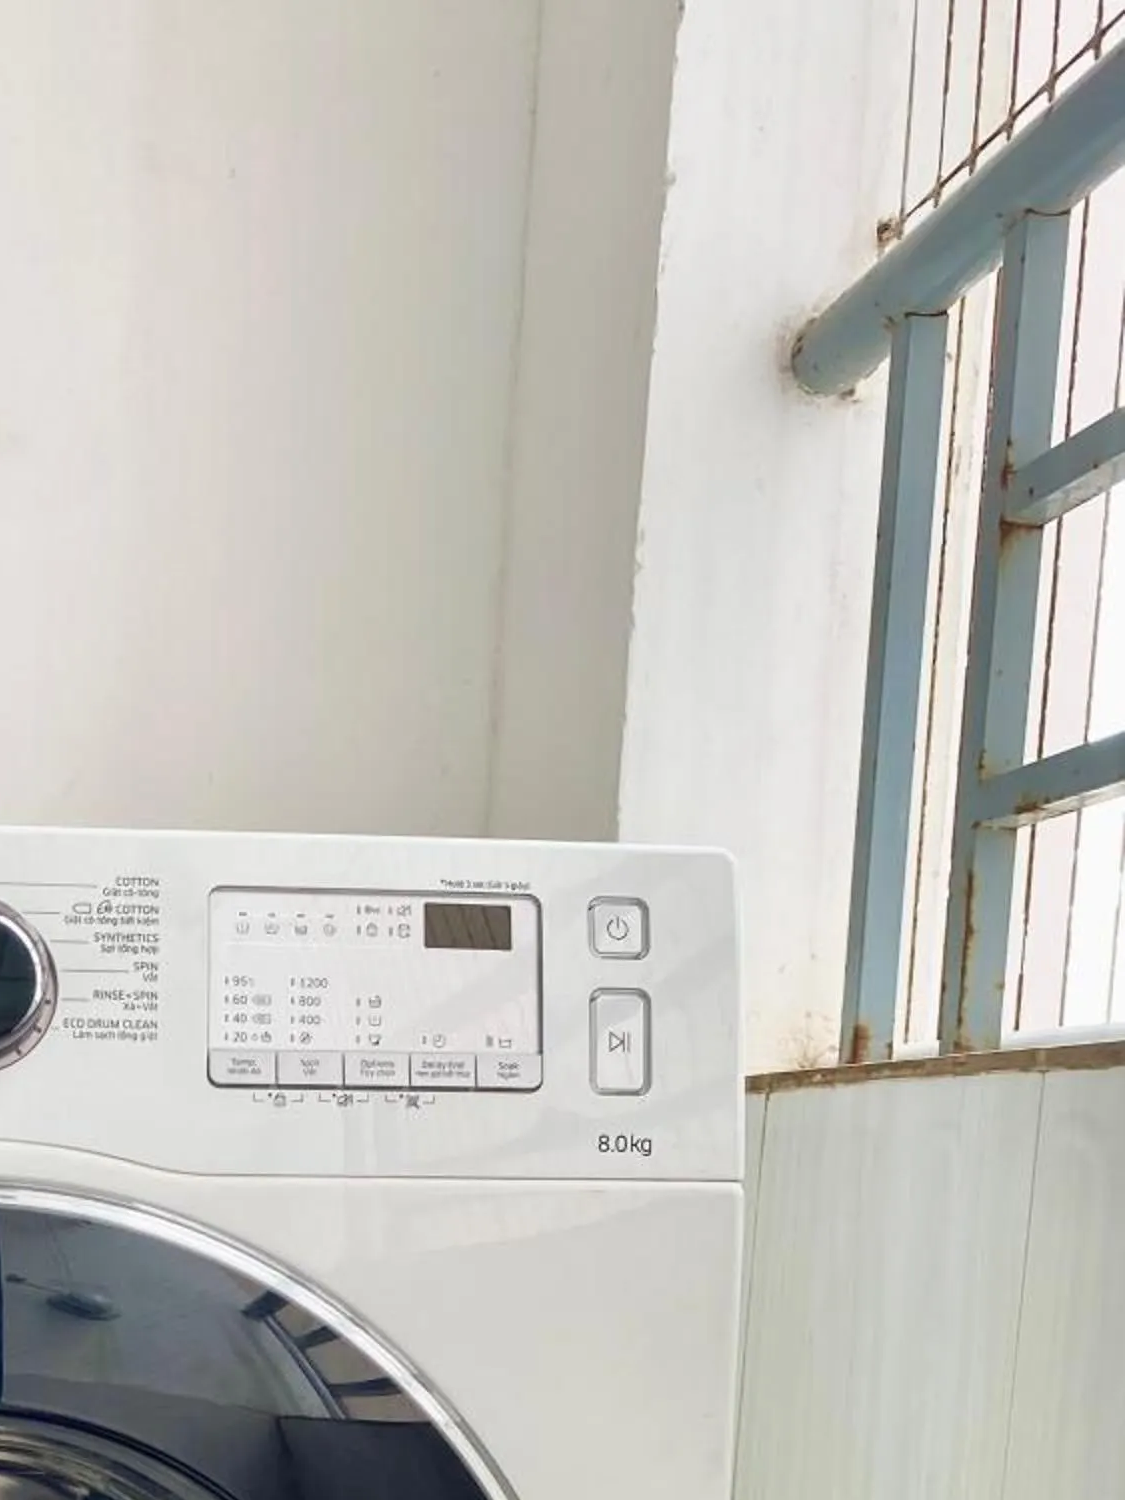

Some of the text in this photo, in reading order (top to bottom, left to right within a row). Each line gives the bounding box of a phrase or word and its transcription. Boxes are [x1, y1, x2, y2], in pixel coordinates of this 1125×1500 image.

[115, 877, 159, 887] COTTON
[115, 905, 159, 915] COTTON
[94, 932, 159, 943] SYNTHETICS
[133, 961, 158, 971] SPIN
[300, 977, 329, 988] 1200
[232, 994, 248, 1005] 60
[62, 1018, 158, 1029] ECO DRUM CLEAN
[232, 1013, 248, 1024] 40
[298, 1014, 322, 1025] 400
